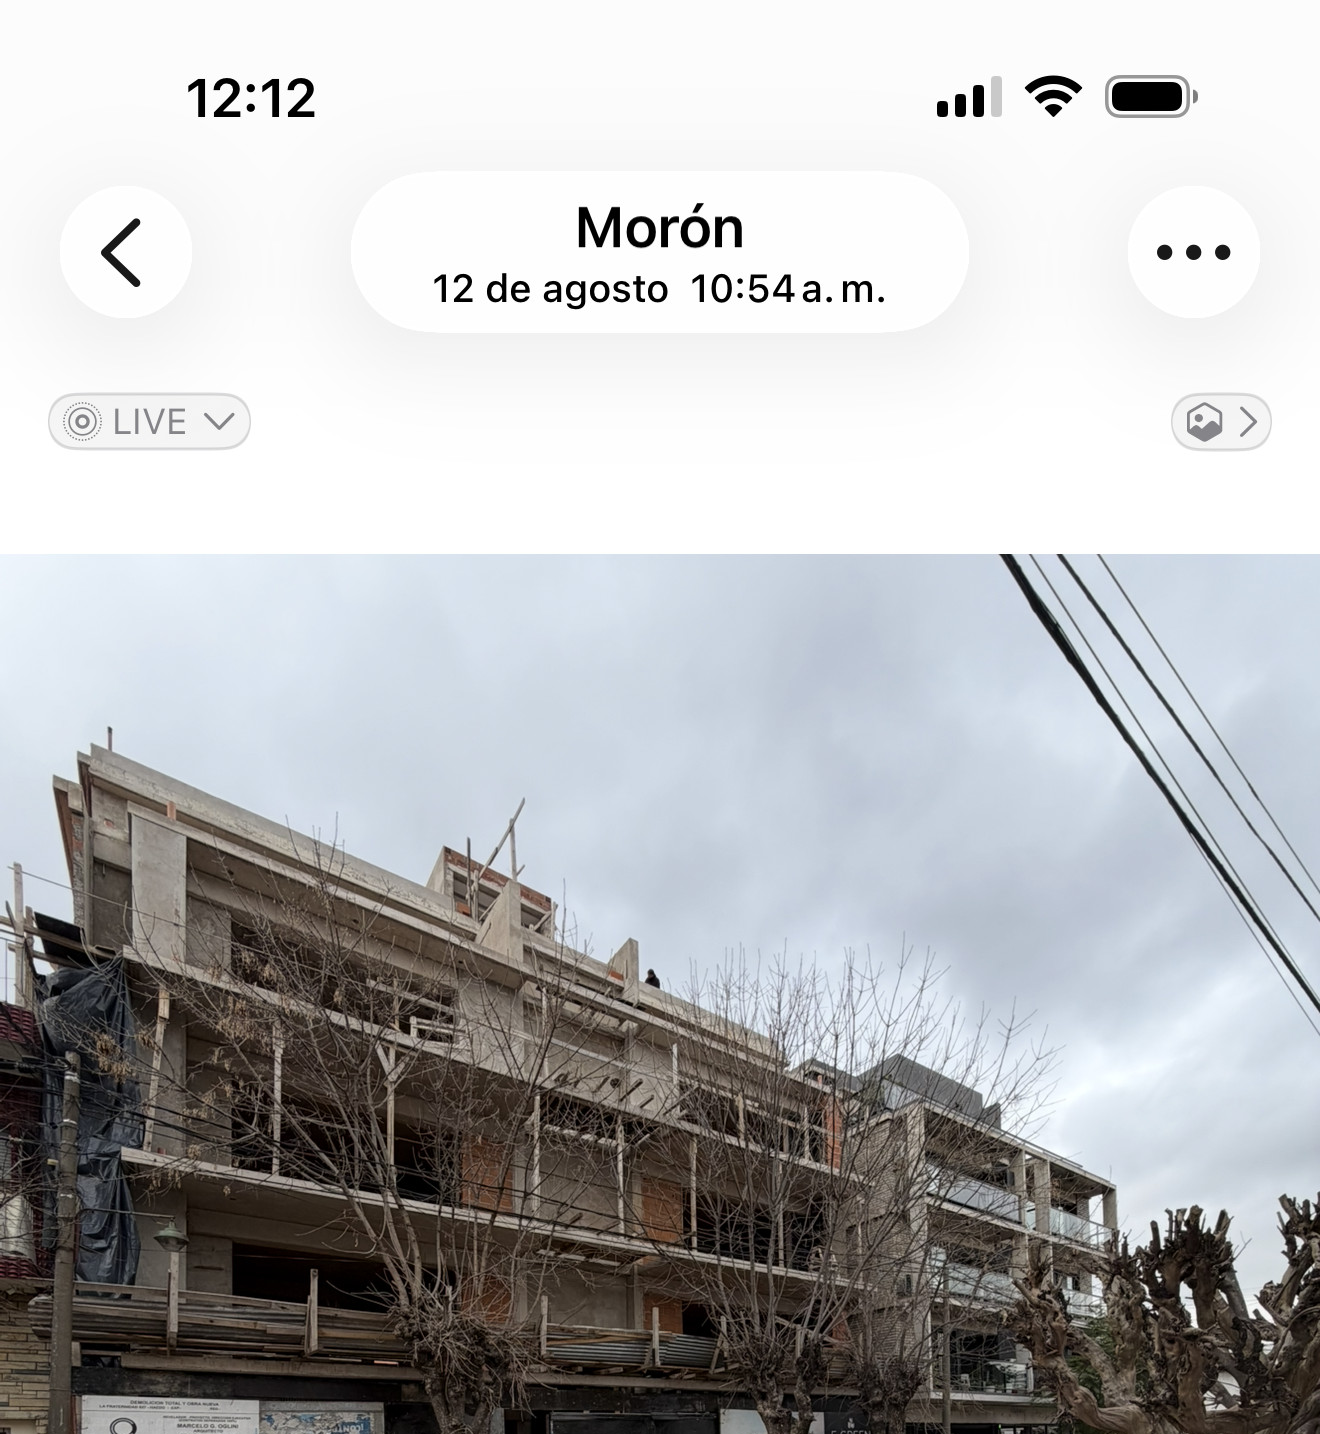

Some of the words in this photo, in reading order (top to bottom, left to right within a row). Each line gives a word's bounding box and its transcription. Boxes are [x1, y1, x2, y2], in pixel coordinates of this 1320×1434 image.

[188, 78, 314, 117] 12:12
[579, 203, 742, 248] Morón
[434, 274, 473, 302] 12
[487, 273, 530, 302] de
[544, 276, 668, 309] agosto
[115, 409, 185, 434] LIVE
